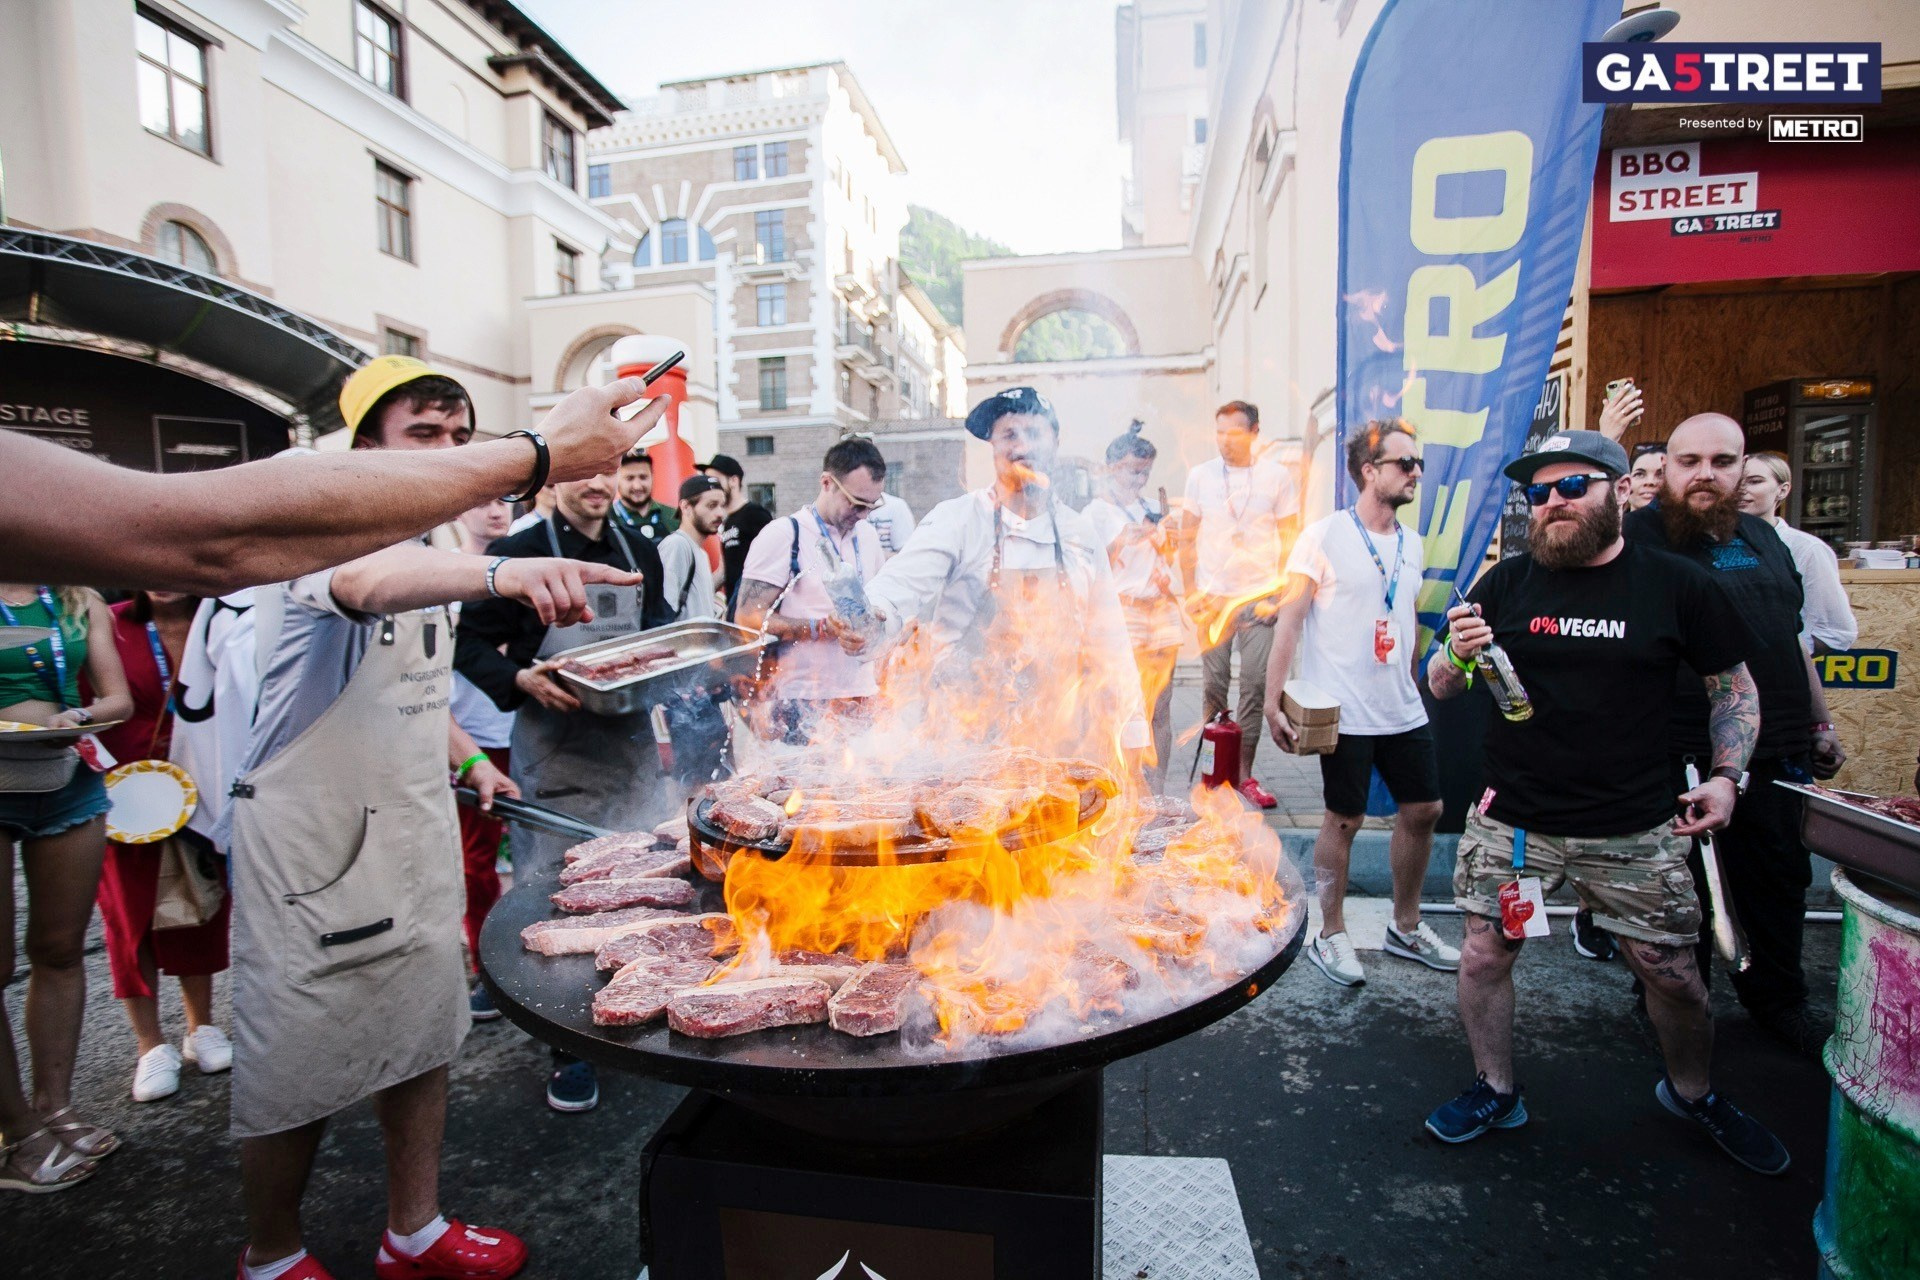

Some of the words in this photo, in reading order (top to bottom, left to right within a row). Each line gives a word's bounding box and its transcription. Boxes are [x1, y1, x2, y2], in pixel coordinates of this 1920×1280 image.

[1619, 151, 1691, 177] BBQ
[1618, 181, 1749, 212] STREET
[1674, 211, 1778, 234] GA5TREET
[0, 404, 90, 426] STAGE
[1529, 616, 1626, 639] 0%VEGAN
